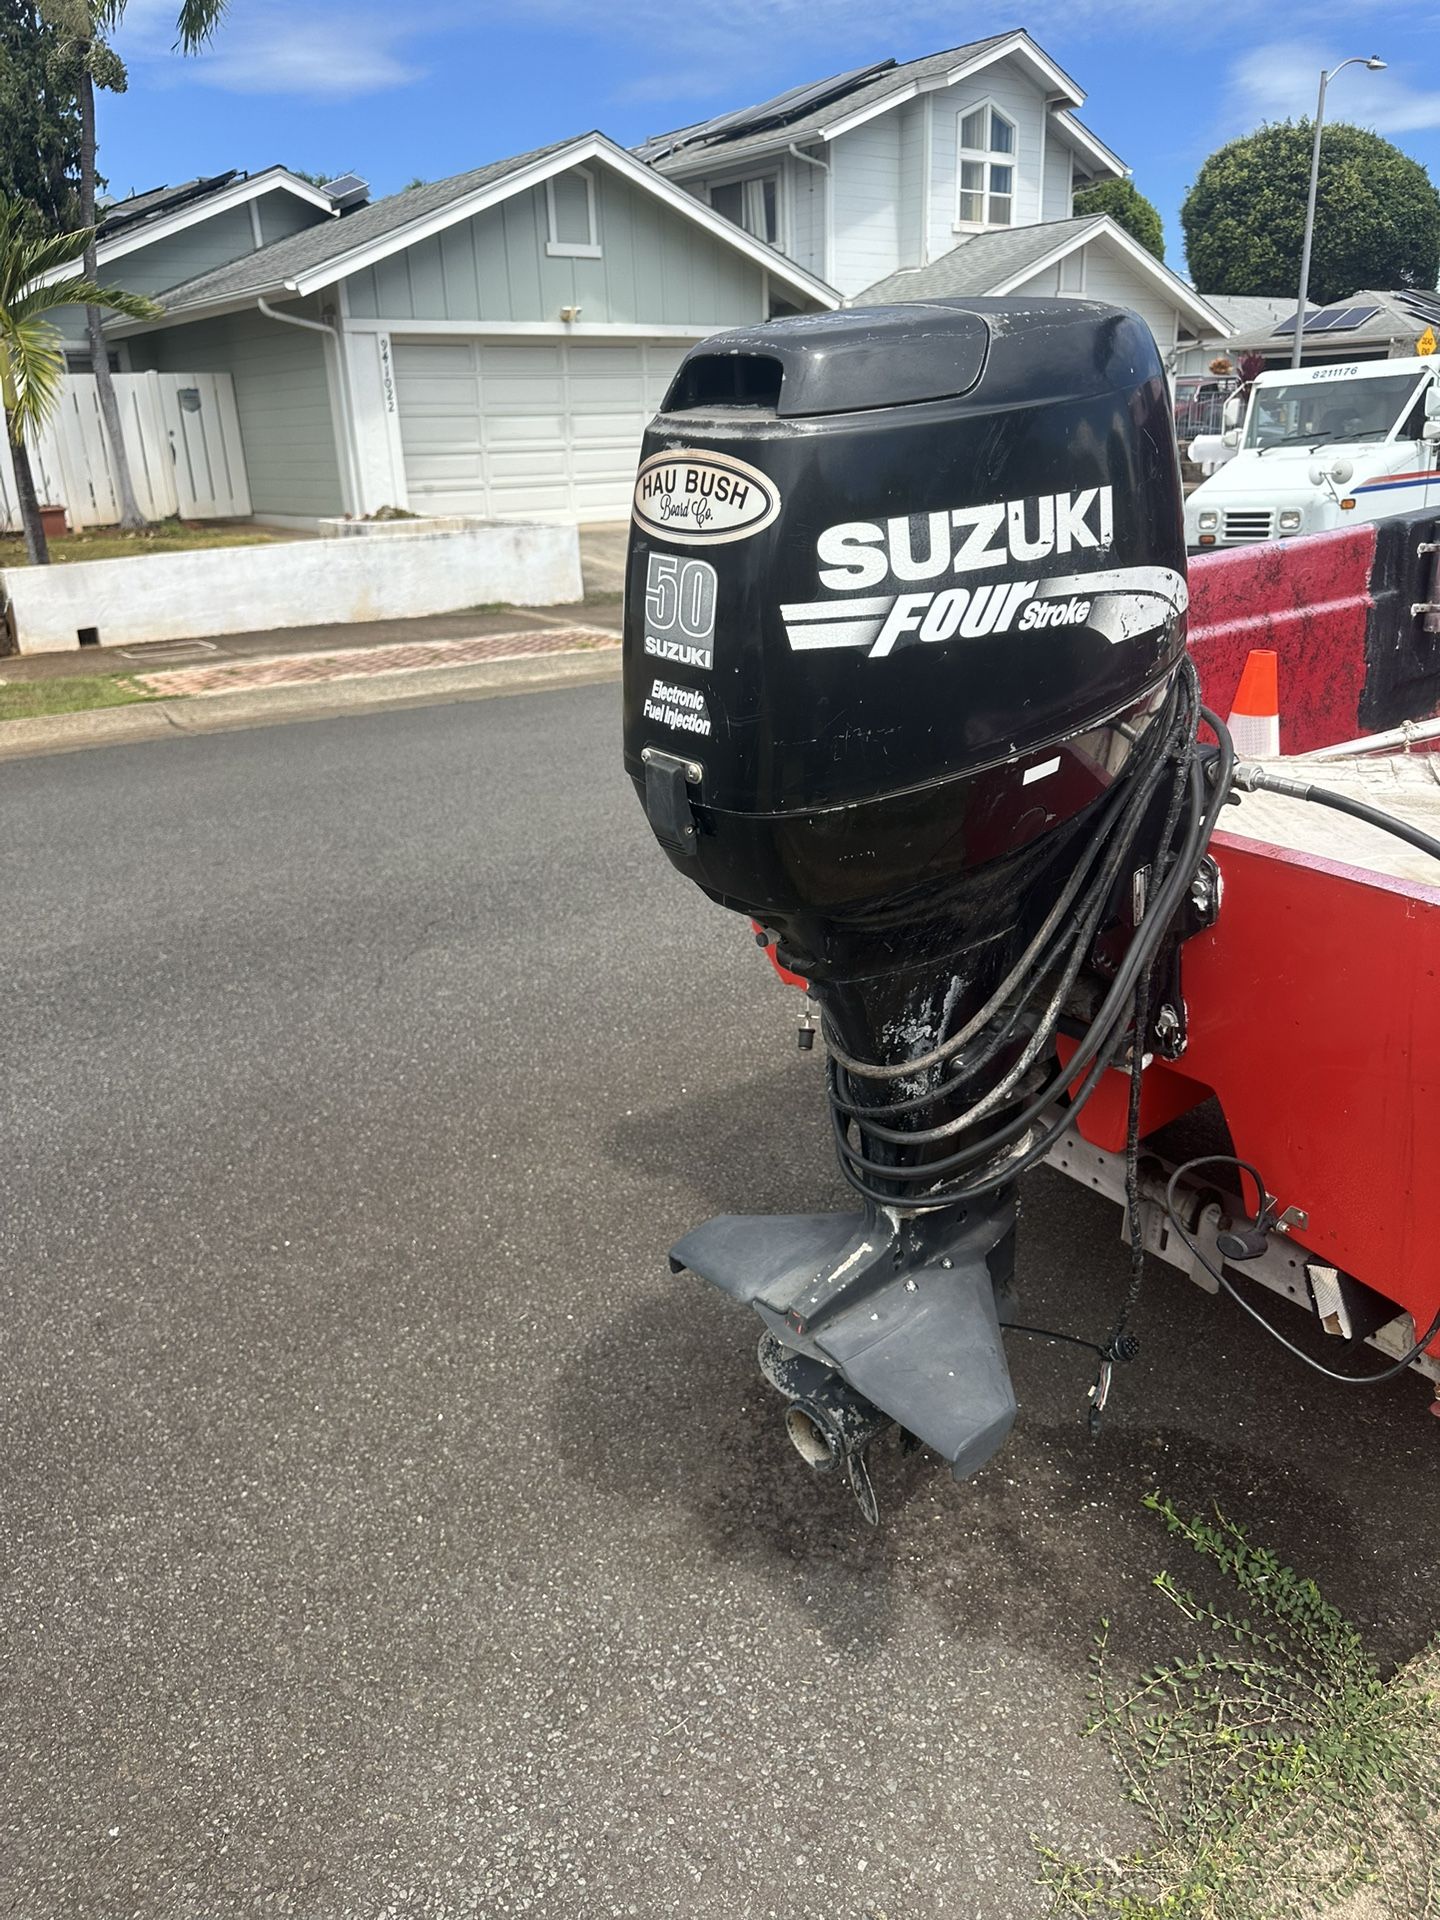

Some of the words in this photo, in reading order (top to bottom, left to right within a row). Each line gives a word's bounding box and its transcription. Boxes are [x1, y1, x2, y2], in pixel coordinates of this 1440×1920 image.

[1312, 366, 1358, 379] 8211176
[643, 469, 676, 500] HAU
[685, 469, 749, 510] BUSH
[660, 494, 690, 520] Board
[692, 497, 713, 528] Co.
[817, 485, 1113, 591] SUZUKI
[645, 553, 718, 637] 50
[1018, 599, 1091, 631] Stroke
[645, 636, 711, 668] SUZUKI
[651, 679, 704, 711] Electronic
[643, 699, 665, 722] Fuel
[663, 705, 711, 736] Injection
